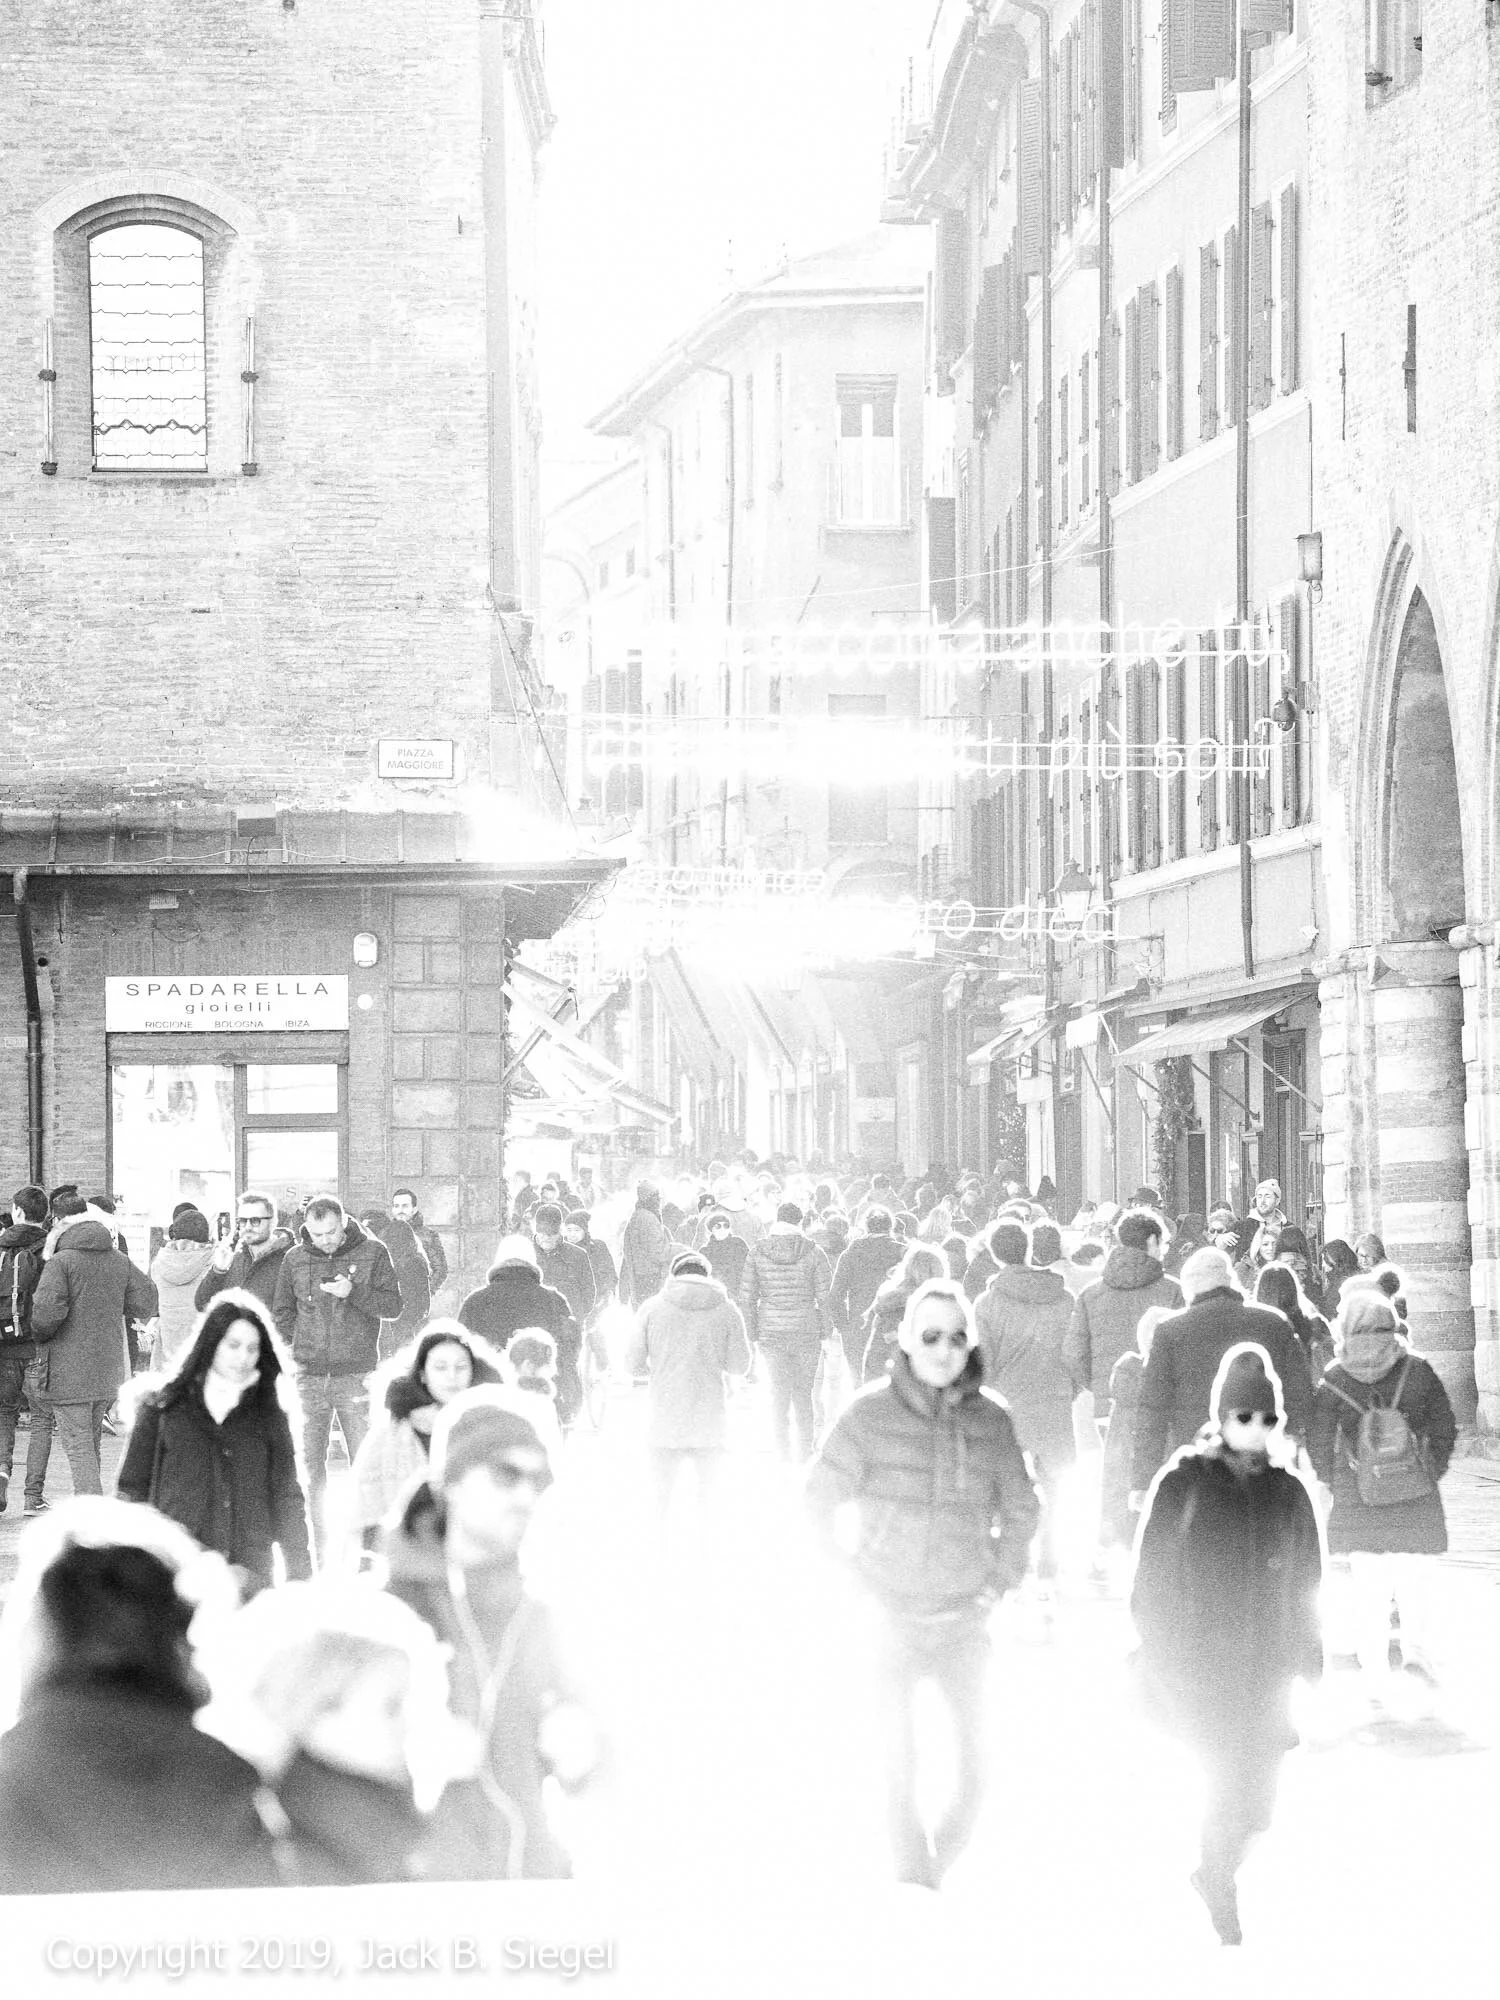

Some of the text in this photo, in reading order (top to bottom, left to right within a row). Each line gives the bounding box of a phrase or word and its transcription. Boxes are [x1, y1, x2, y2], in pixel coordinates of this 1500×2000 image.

[1012, 604, 1185, 670] anche
[398, 748, 434, 757] PIAZZA
[1047, 721, 1127, 799] più
[1152, 717, 1283, 781] soli?
[387, 760, 444, 770] MAGGIORE
[126, 982, 329, 997] SPADARELLA
[185, 1001, 271, 1015] gioielli
[145, 1020, 310, 1029] RICCIONE BOLOGNA IBIZA
